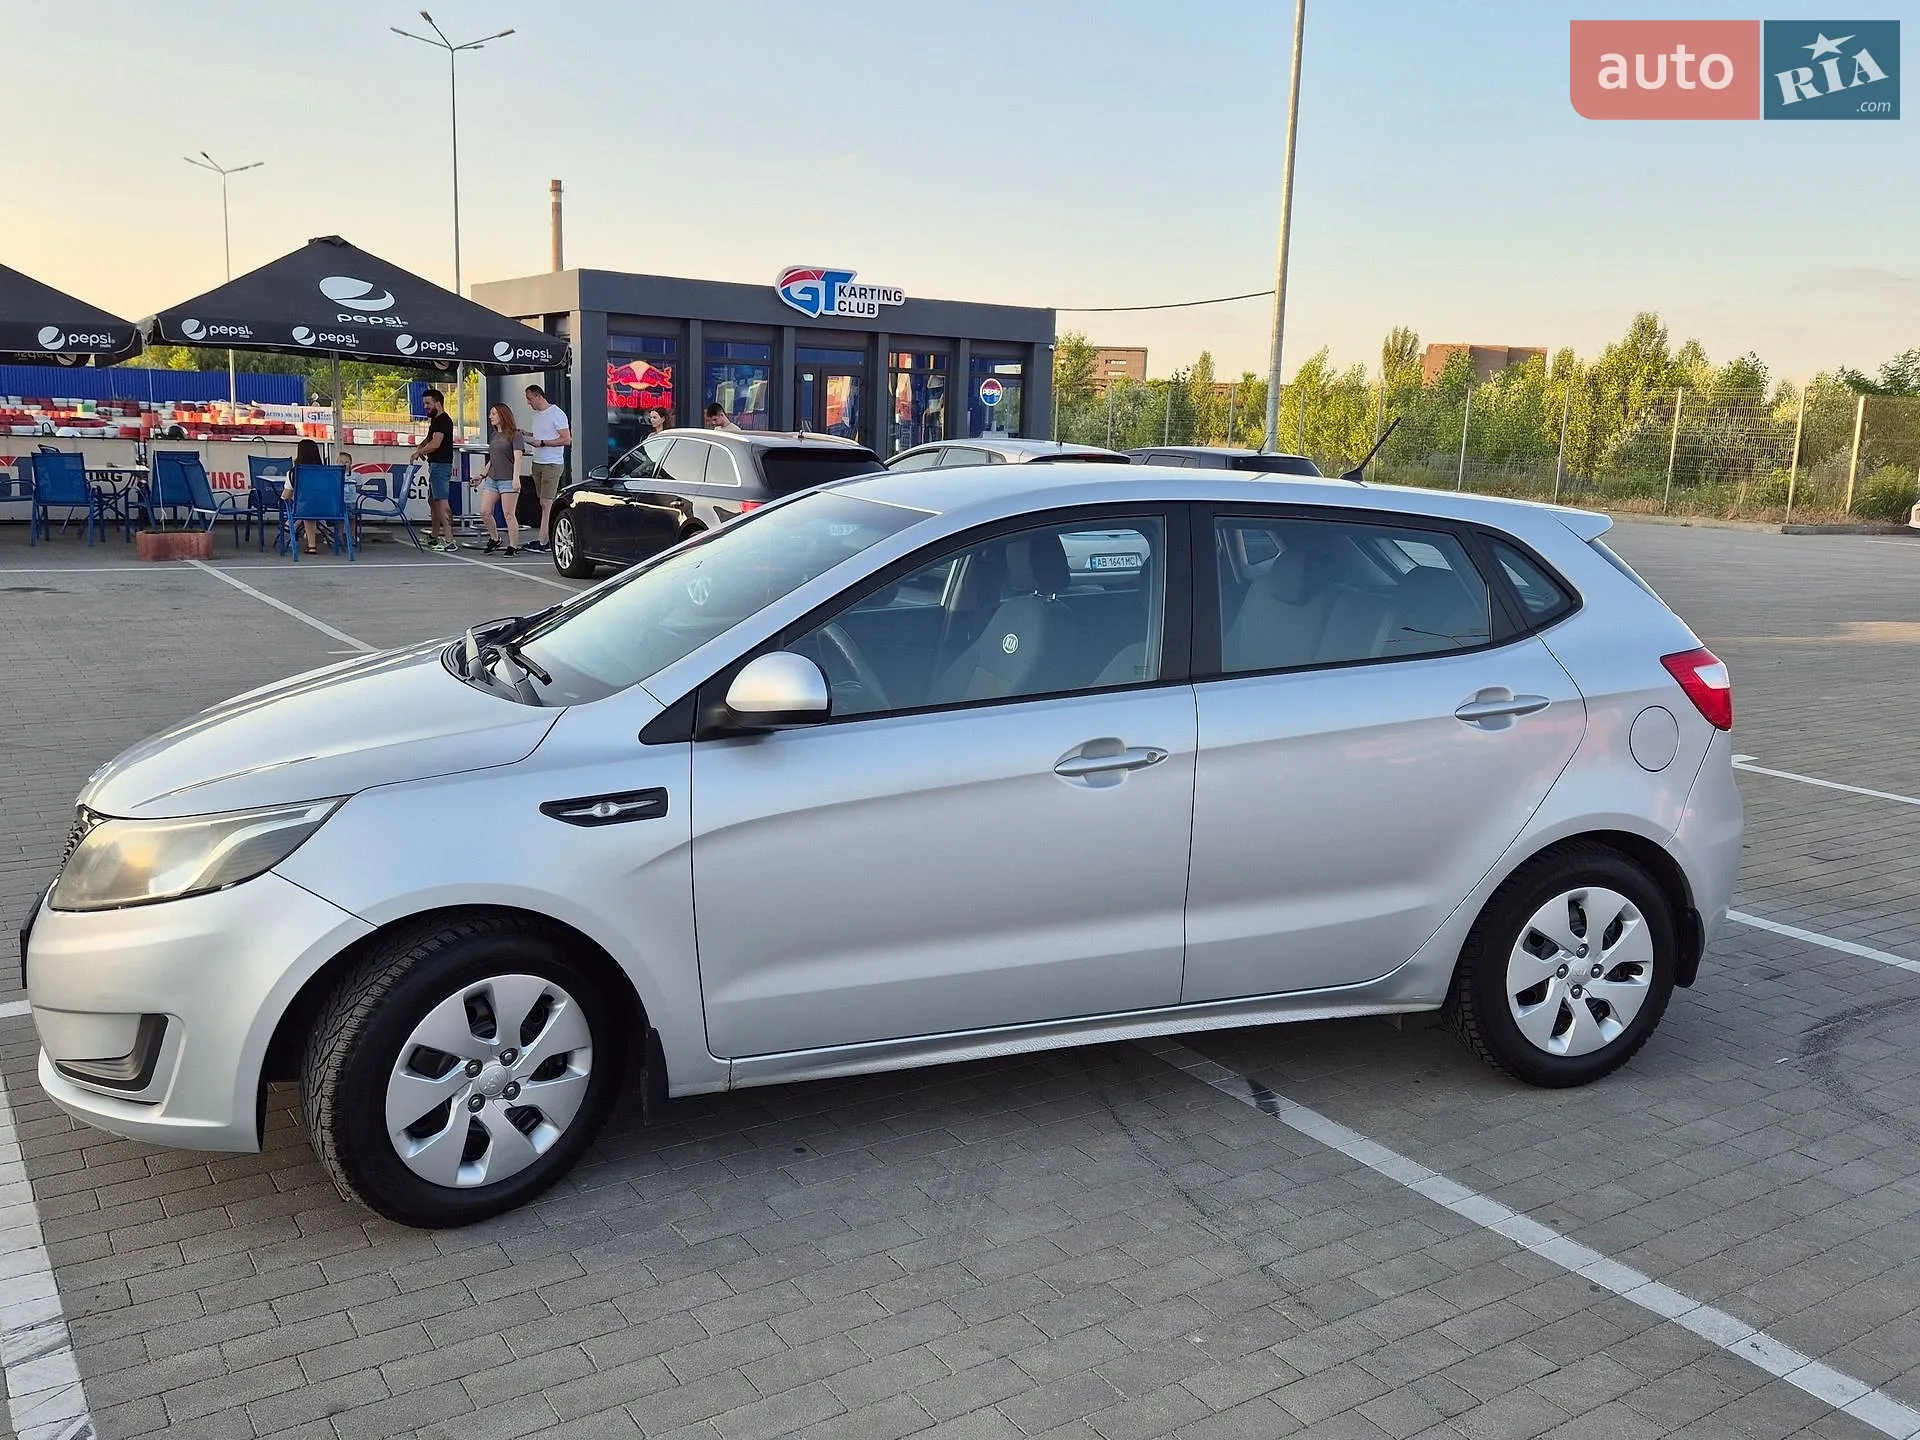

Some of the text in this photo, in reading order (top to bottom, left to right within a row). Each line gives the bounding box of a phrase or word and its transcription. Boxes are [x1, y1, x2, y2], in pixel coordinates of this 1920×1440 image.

[779, 269, 903, 315] GT KARTING
[838, 300, 876, 315] CLUB
[336, 313, 402, 325] pepsi
[209, 325, 249, 337] pepsi
[68, 332, 111, 346] pepsi
[318, 333, 355, 345] pepsi
[420, 341, 455, 354] pepsi
[516, 348, 549, 360] pepsi
[607, 388, 672, 409] Red Bull
